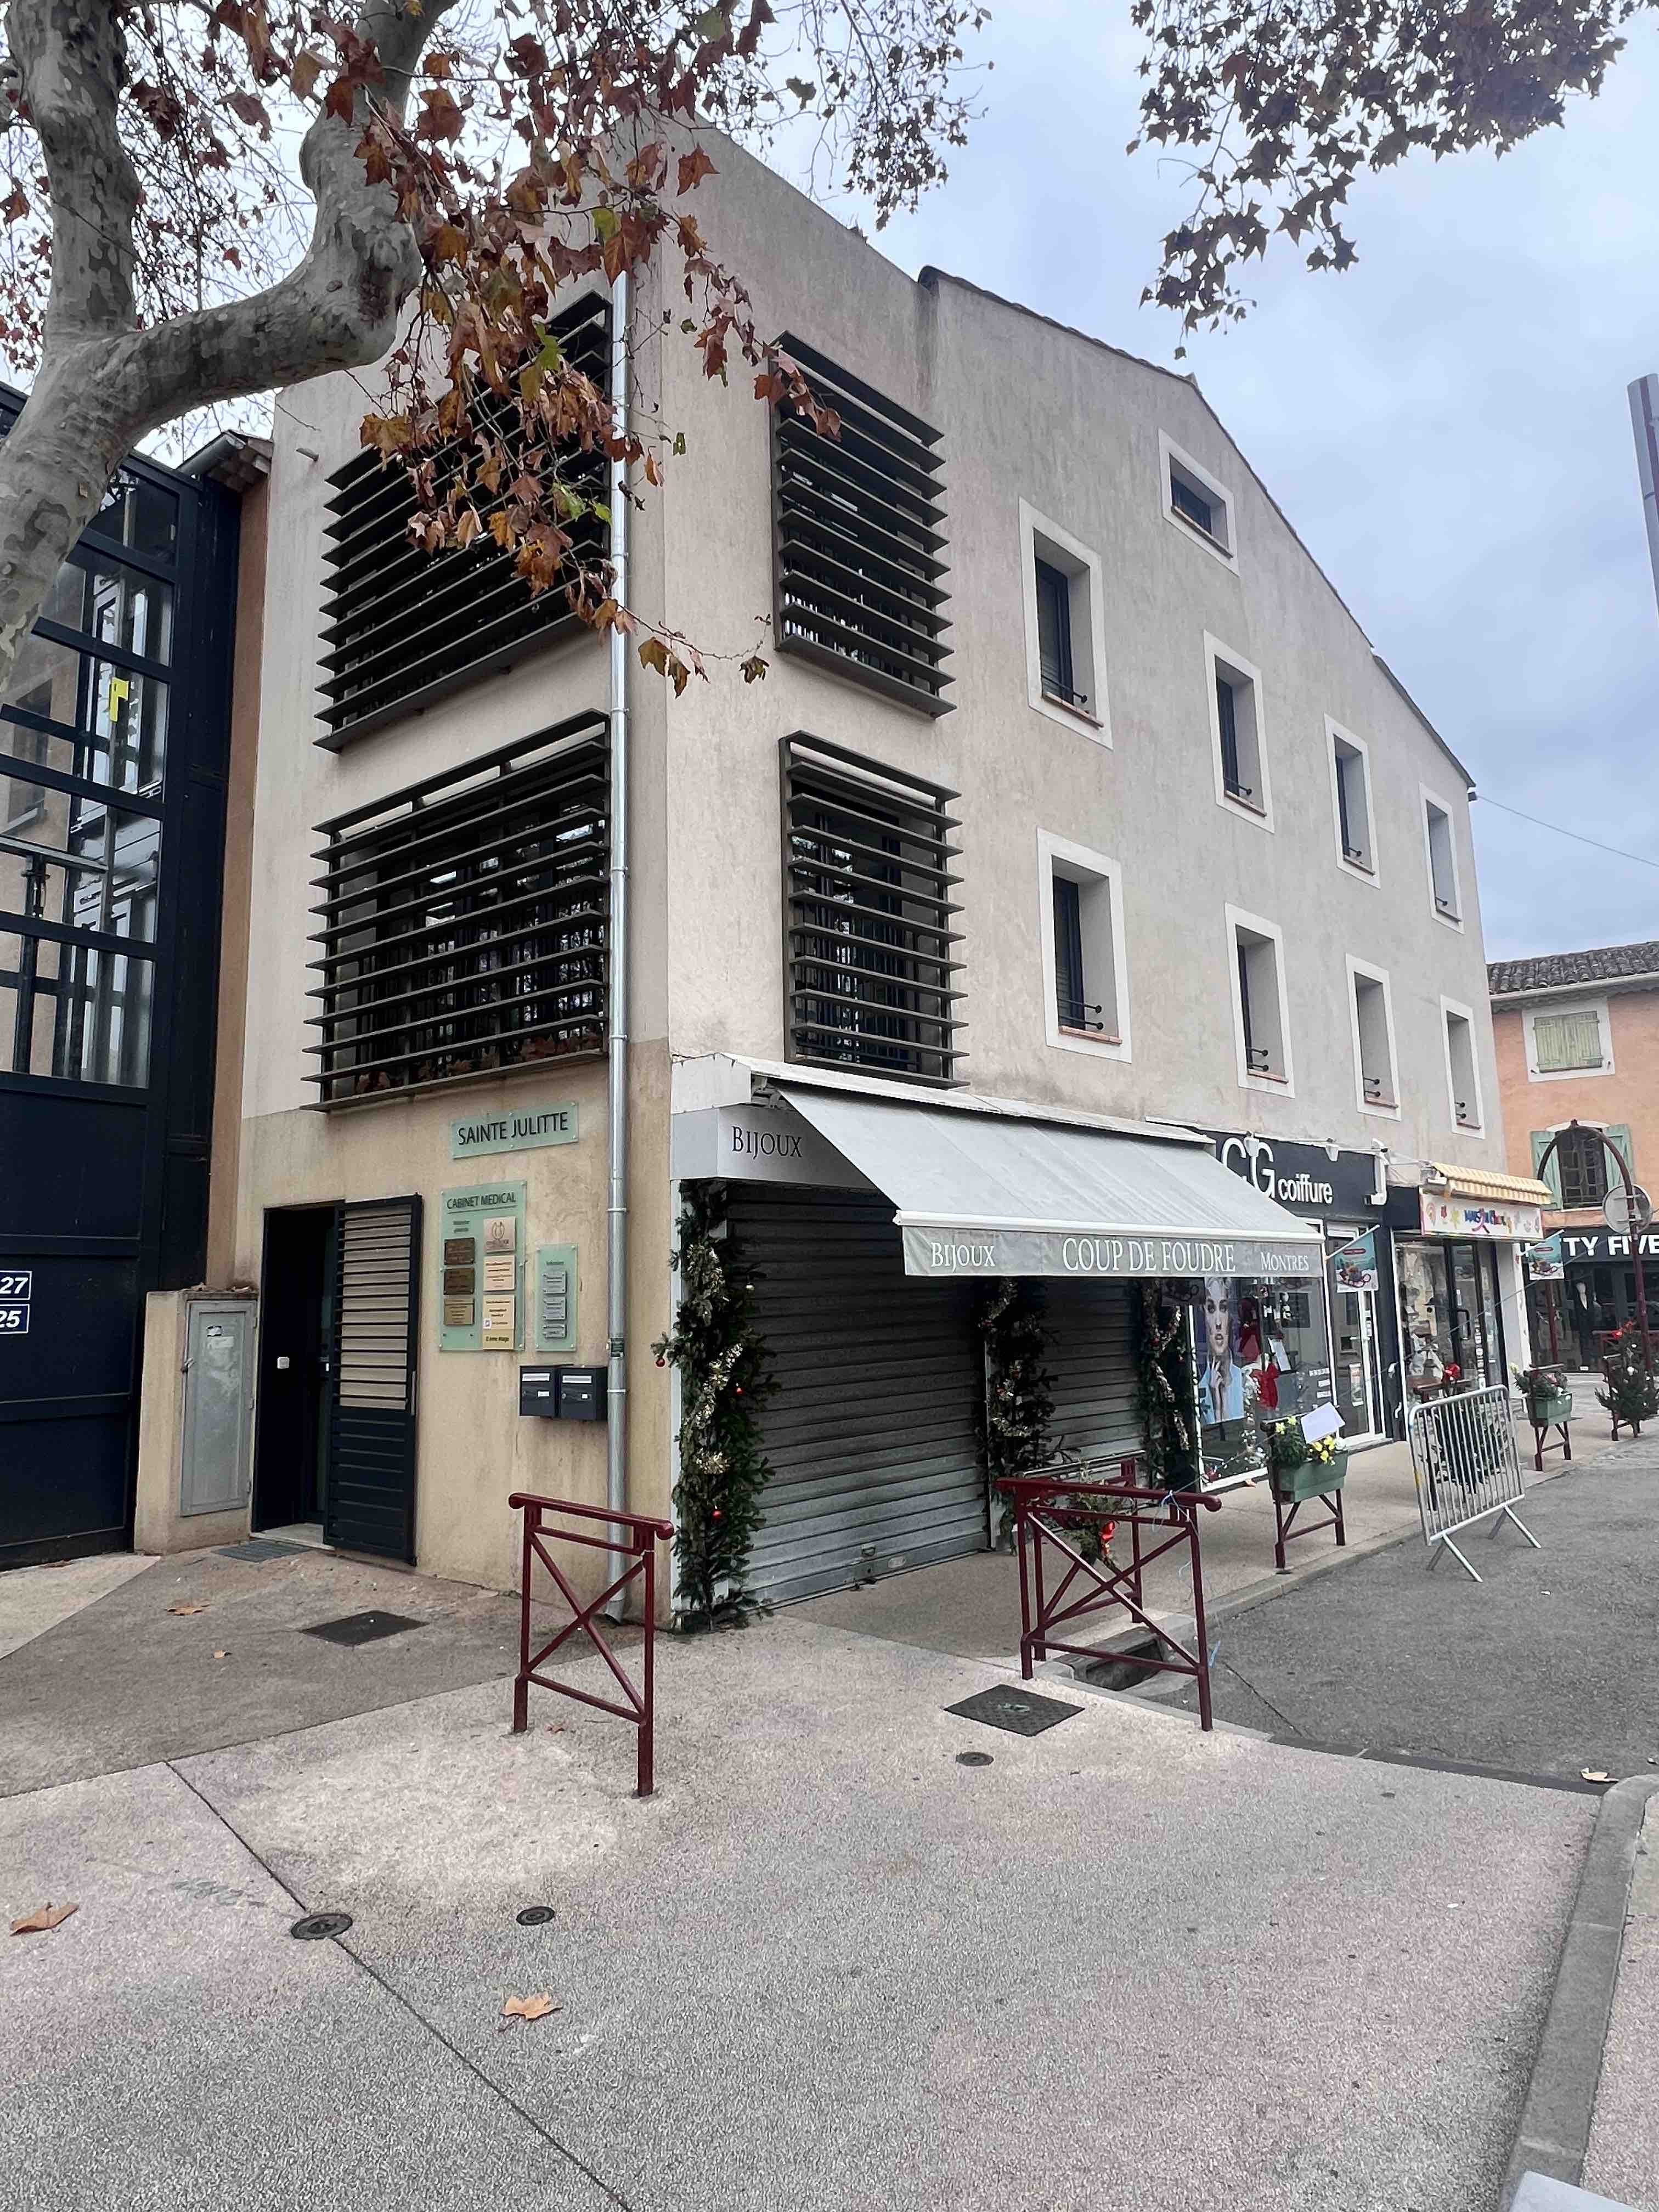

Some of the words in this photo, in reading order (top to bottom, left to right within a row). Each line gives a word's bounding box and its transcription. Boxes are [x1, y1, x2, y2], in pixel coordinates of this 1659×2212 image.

[458, 1121, 507, 1146] SAINTE
[511, 1111, 568, 1138] JULITTE
[732, 1126, 802, 1160] BIJOUX
[447, 1195, 479, 1209] CABINET
[481, 1192, 516, 1206] MEDICAL
[1277, 1173, 1334, 1204] coiffure
[930, 1242, 996, 1272] BIJOUX
[1062, 1237, 1123, 1271] COUP
[1127, 1240, 1156, 1271] DE
[1161, 1242, 1236, 1273] FOUDRE
[1261, 1251, 1310, 1272] MONTRES
